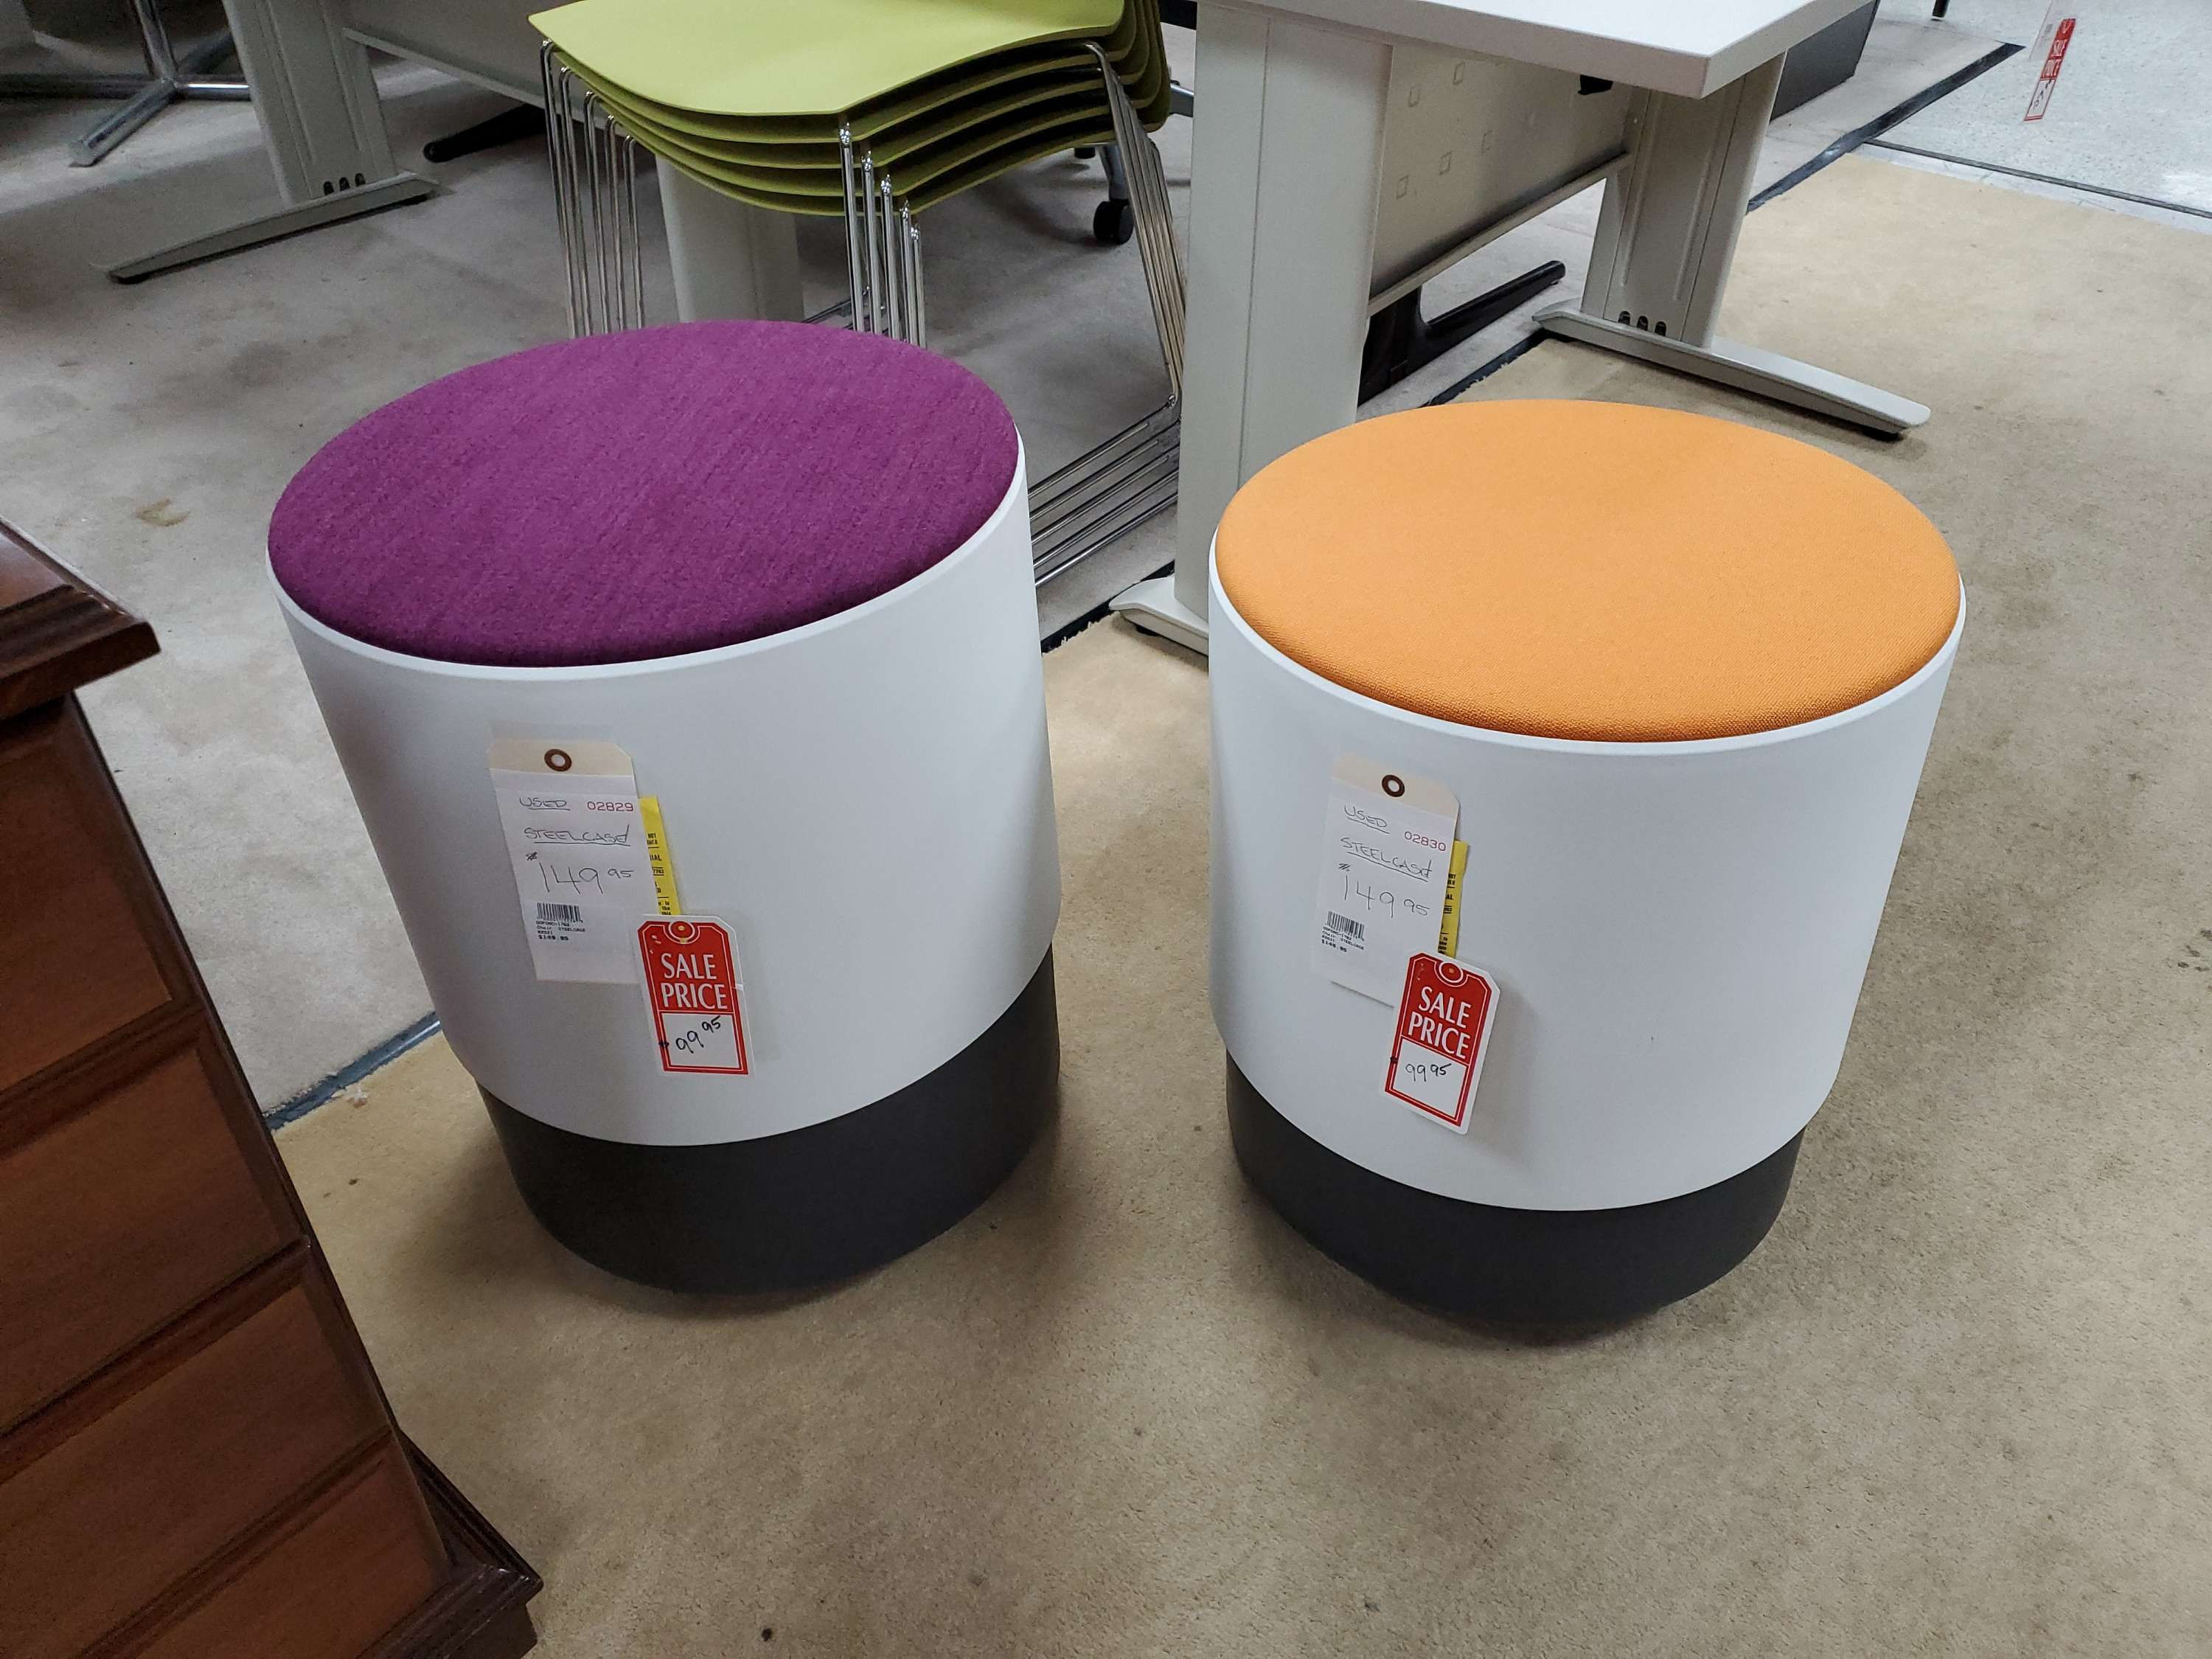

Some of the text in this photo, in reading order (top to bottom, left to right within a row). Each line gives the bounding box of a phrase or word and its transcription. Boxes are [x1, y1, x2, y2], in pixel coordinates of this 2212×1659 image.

[519, 797, 634, 812] USED 02829
[1344, 805, 1446, 852] USED 02830
[661, 953, 717, 980] SALE
[661, 982, 727, 1009] PRICE
[1418, 986, 1472, 1029] SALE
[1408, 1012, 1470, 1060] PRICE
